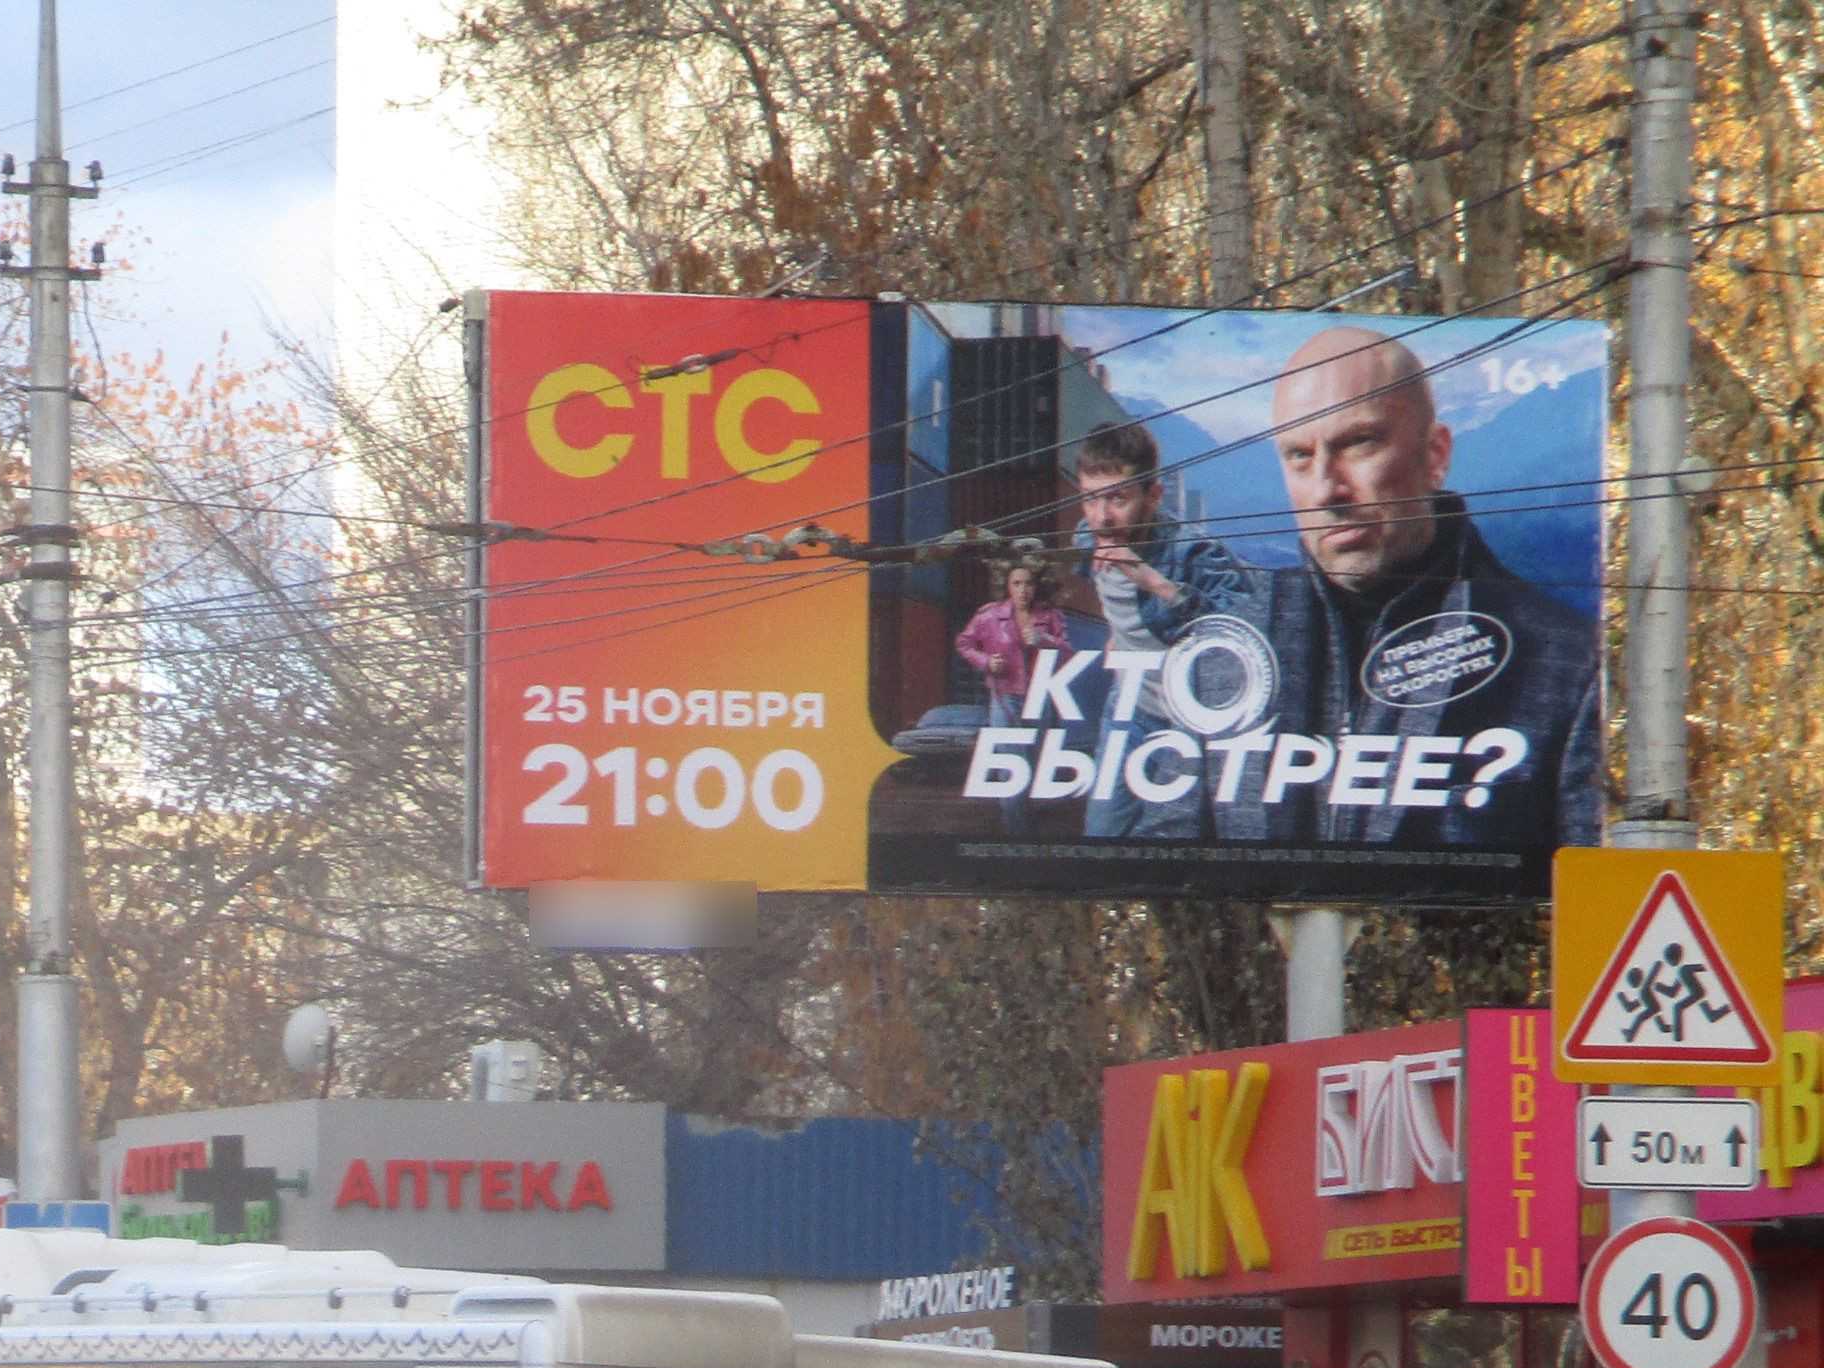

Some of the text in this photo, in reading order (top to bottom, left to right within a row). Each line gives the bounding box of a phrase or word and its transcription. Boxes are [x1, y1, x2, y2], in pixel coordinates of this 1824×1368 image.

[1480, 358, 1568, 395] 16+
[527, 363, 823, 483] СТС
[1375, 635, 1495, 684] НА ВЫСОКИХ
[1383, 624, 1479, 663] ПРЕМЬЕРА
[1021, 613, 1280, 736] КТО
[1387, 653, 1496, 698] СКОРОСТЯХ
[523, 685, 825, 728] 25 НОЯБРЯ
[522, 743, 825, 832] 21:00
[963, 727, 1530, 808] БЫСТРЕЕ?
[1505, 1015, 1544, 1297] ЦВЕТЫ
[334, 1157, 614, 1213] АПТЕКА
[878, 1265, 1016, 1321] МОРОЖЕНОЕ
[1620, 1272, 1719, 1341] 40
